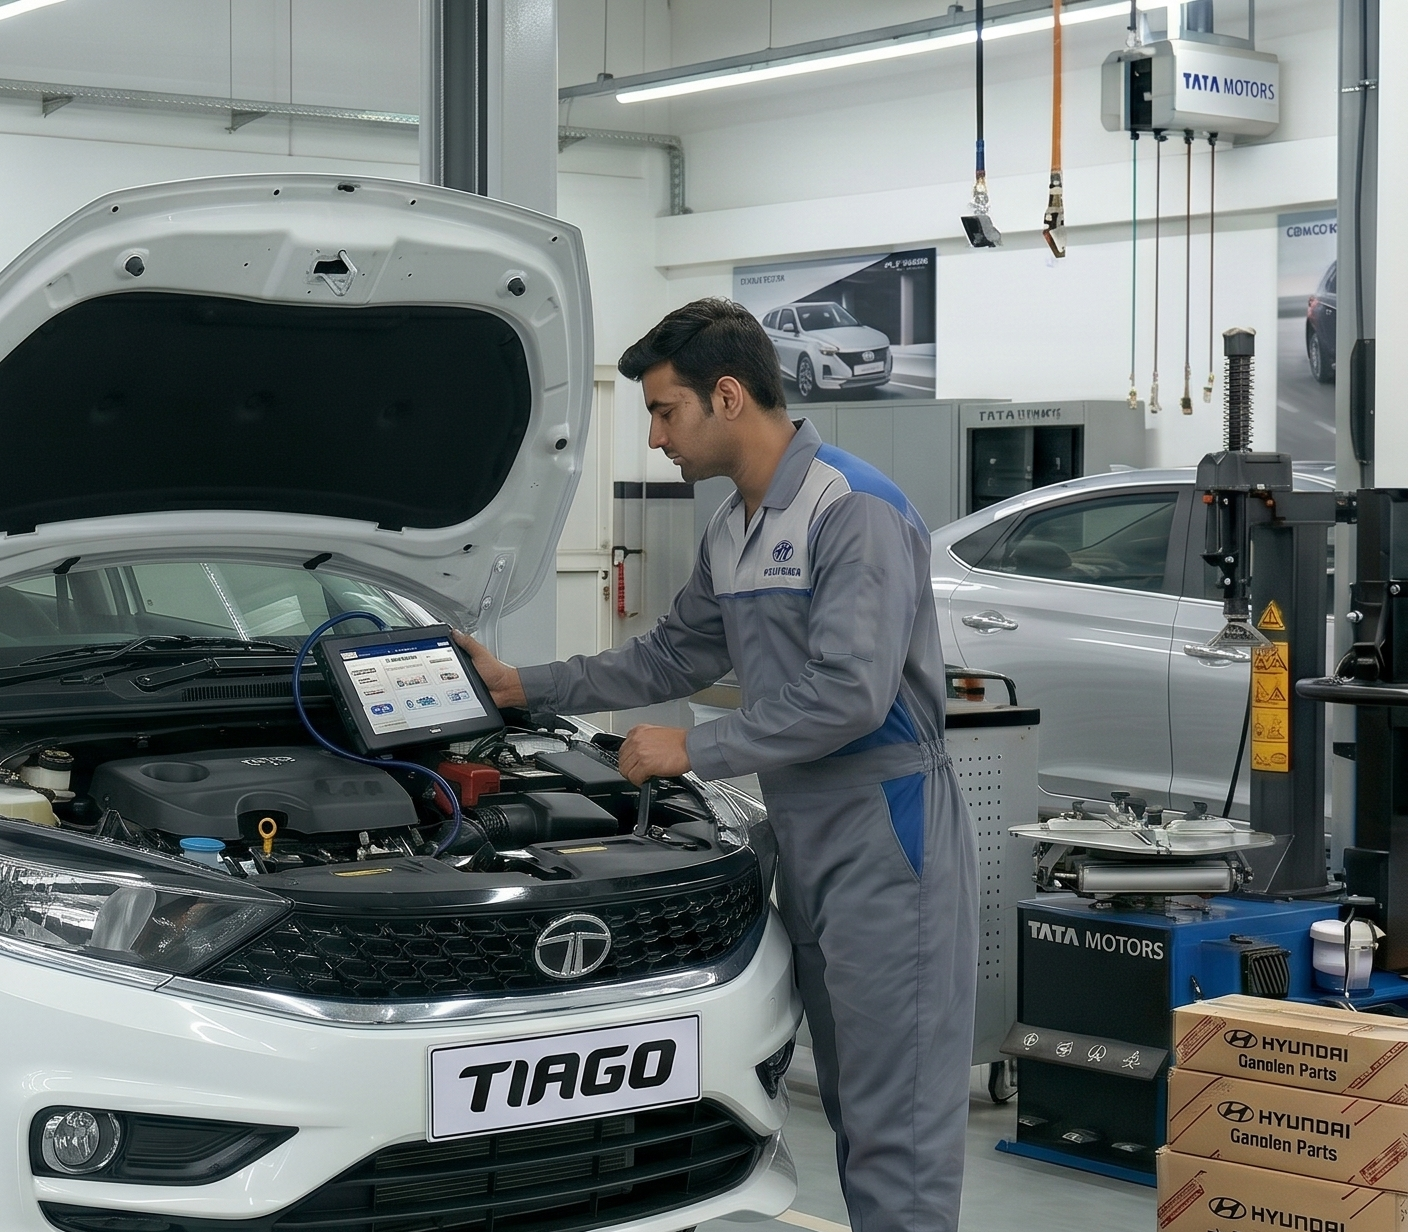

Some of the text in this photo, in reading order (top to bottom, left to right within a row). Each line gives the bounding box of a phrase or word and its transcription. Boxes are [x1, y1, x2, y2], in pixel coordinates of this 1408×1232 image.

[1183, 72, 1275, 100] TATA MOTORS
[979, 410, 1015, 421] TATA
[1027, 920, 1164, 960] TATA MOTORS
[1262, 1036, 1348, 1063] HYUNDAI
[458, 1038, 677, 1113] TIAGO
[1299, 1062, 1337, 1082] Parts
[1258, 1109, 1351, 1140] HYUNDAI
[1296, 1138, 1338, 1162] Parts
